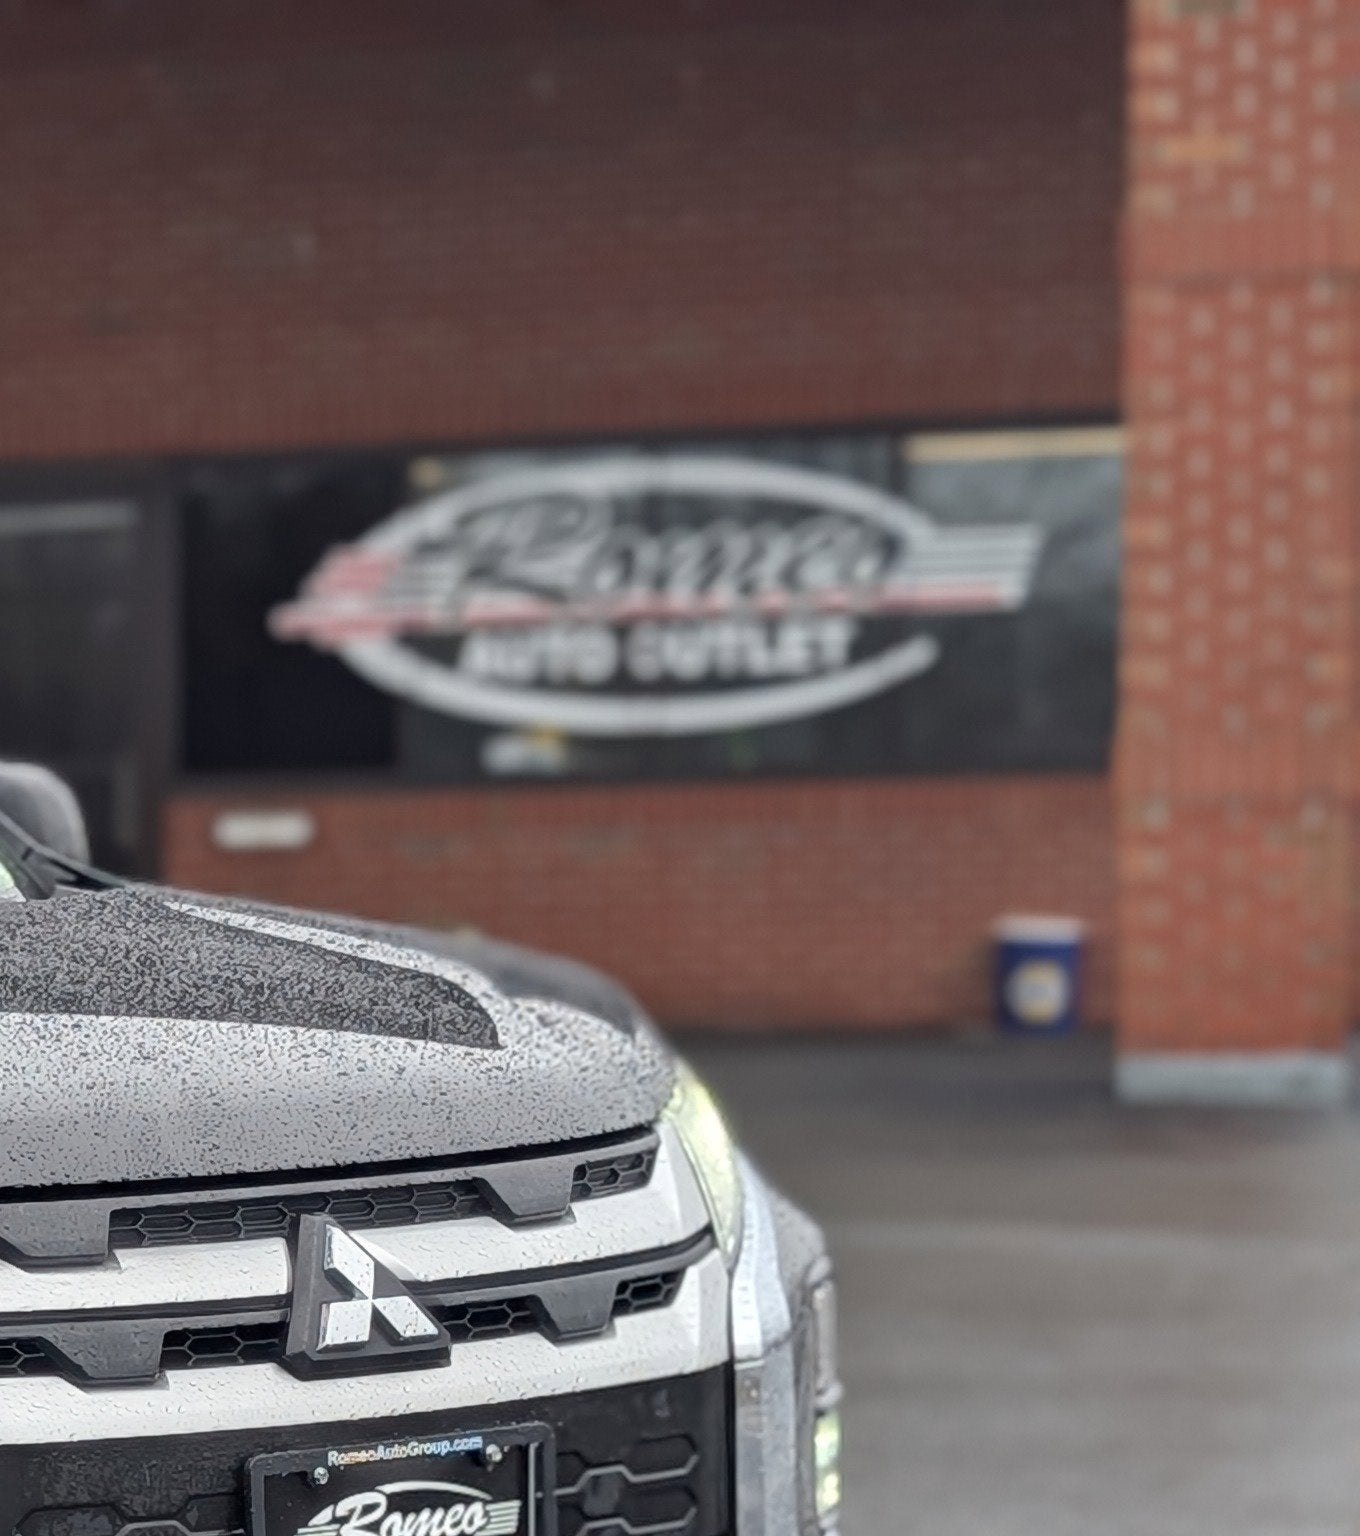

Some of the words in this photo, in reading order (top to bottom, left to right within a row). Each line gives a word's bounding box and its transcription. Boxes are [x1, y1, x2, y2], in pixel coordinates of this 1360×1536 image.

[456, 624, 618, 683] AUTO
[623, 612, 859, 683] OUTLET
[327, 1435, 484, 1467] RomeoAutoGroup.com
